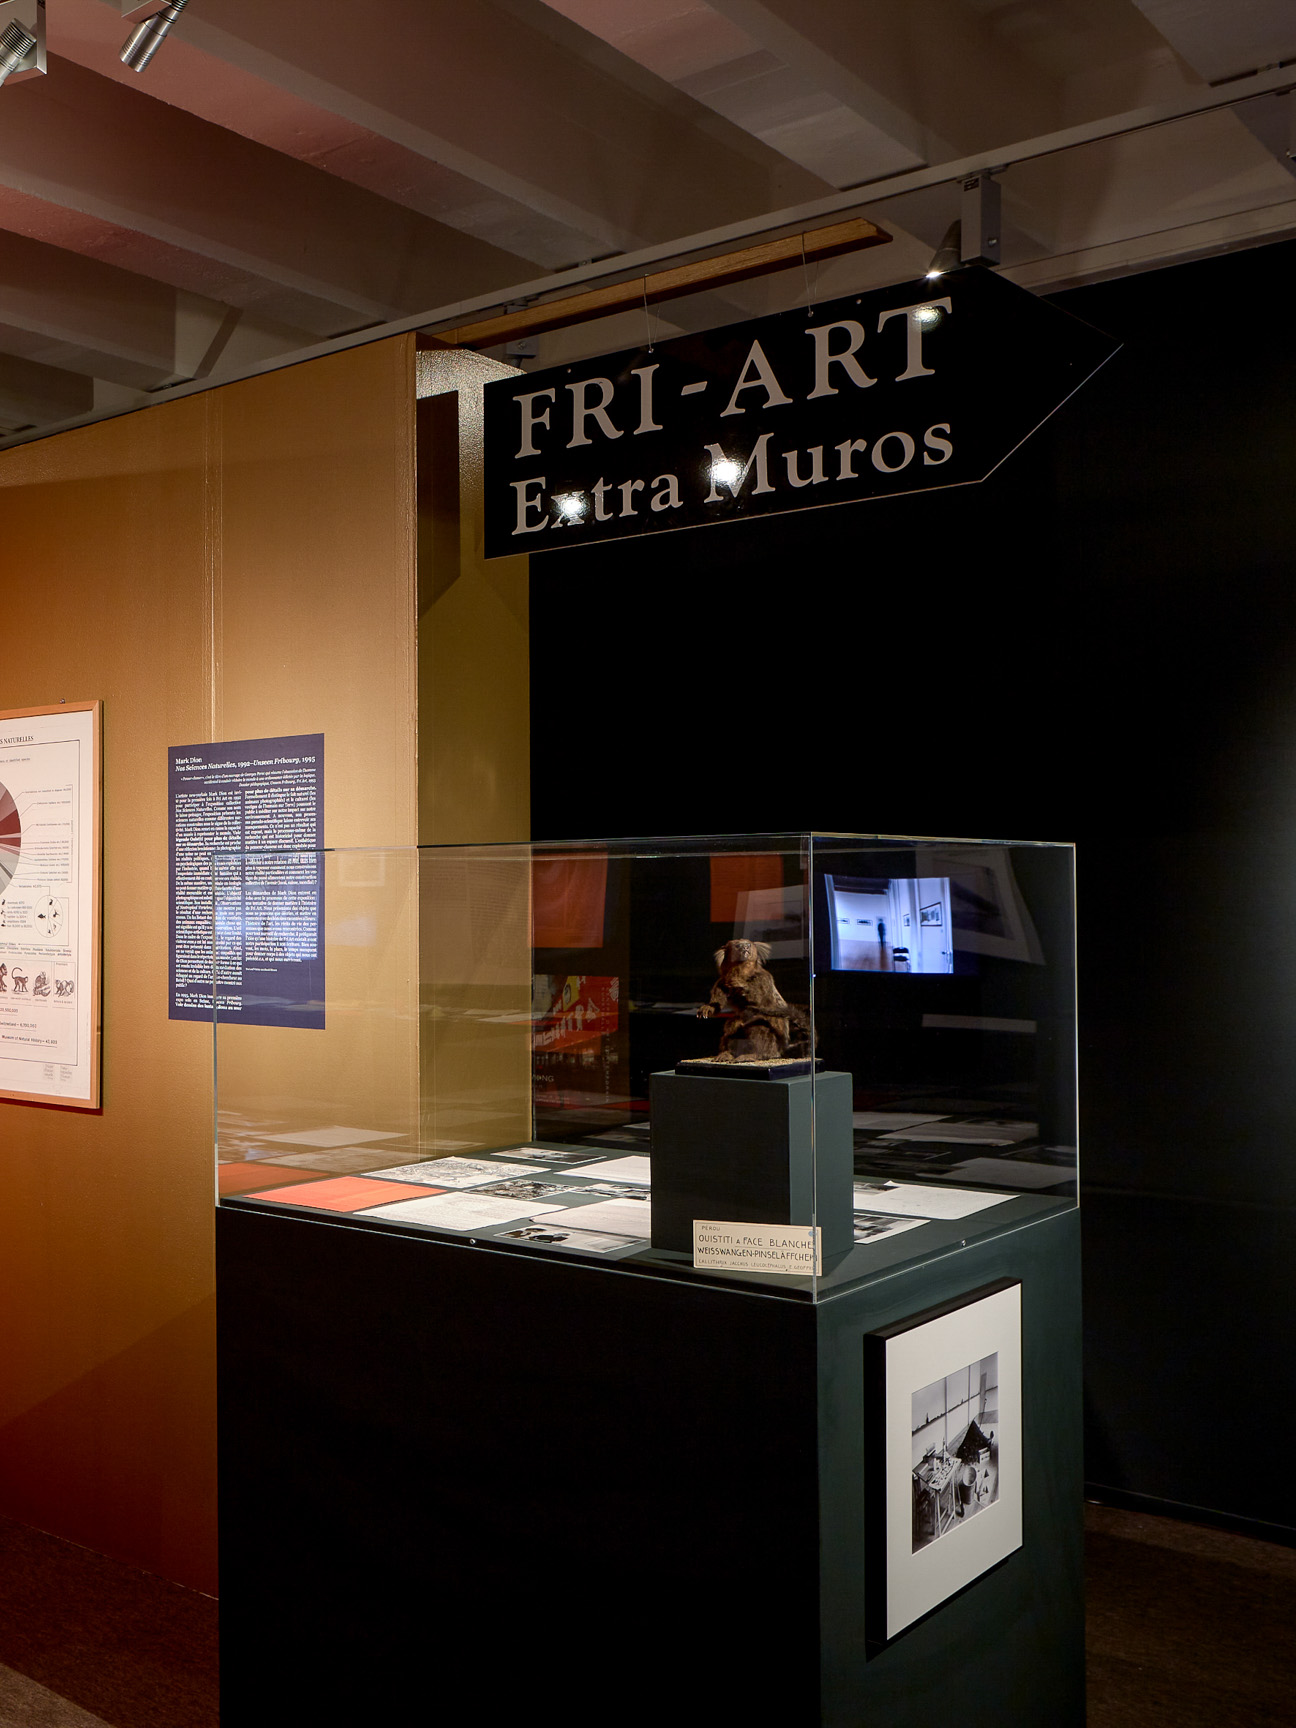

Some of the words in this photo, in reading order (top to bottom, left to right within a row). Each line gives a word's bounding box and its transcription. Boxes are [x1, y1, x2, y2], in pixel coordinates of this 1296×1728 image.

[512, 472, 683, 536] Extra
[704, 422, 953, 504] Muros
[4, 736, 34, 744] NATURELLES
[699, 1235, 732, 1244] OUISTITI
[744, 1237, 763, 1246] FACE
[770, 1239, 814, 1249] BLANCHE
